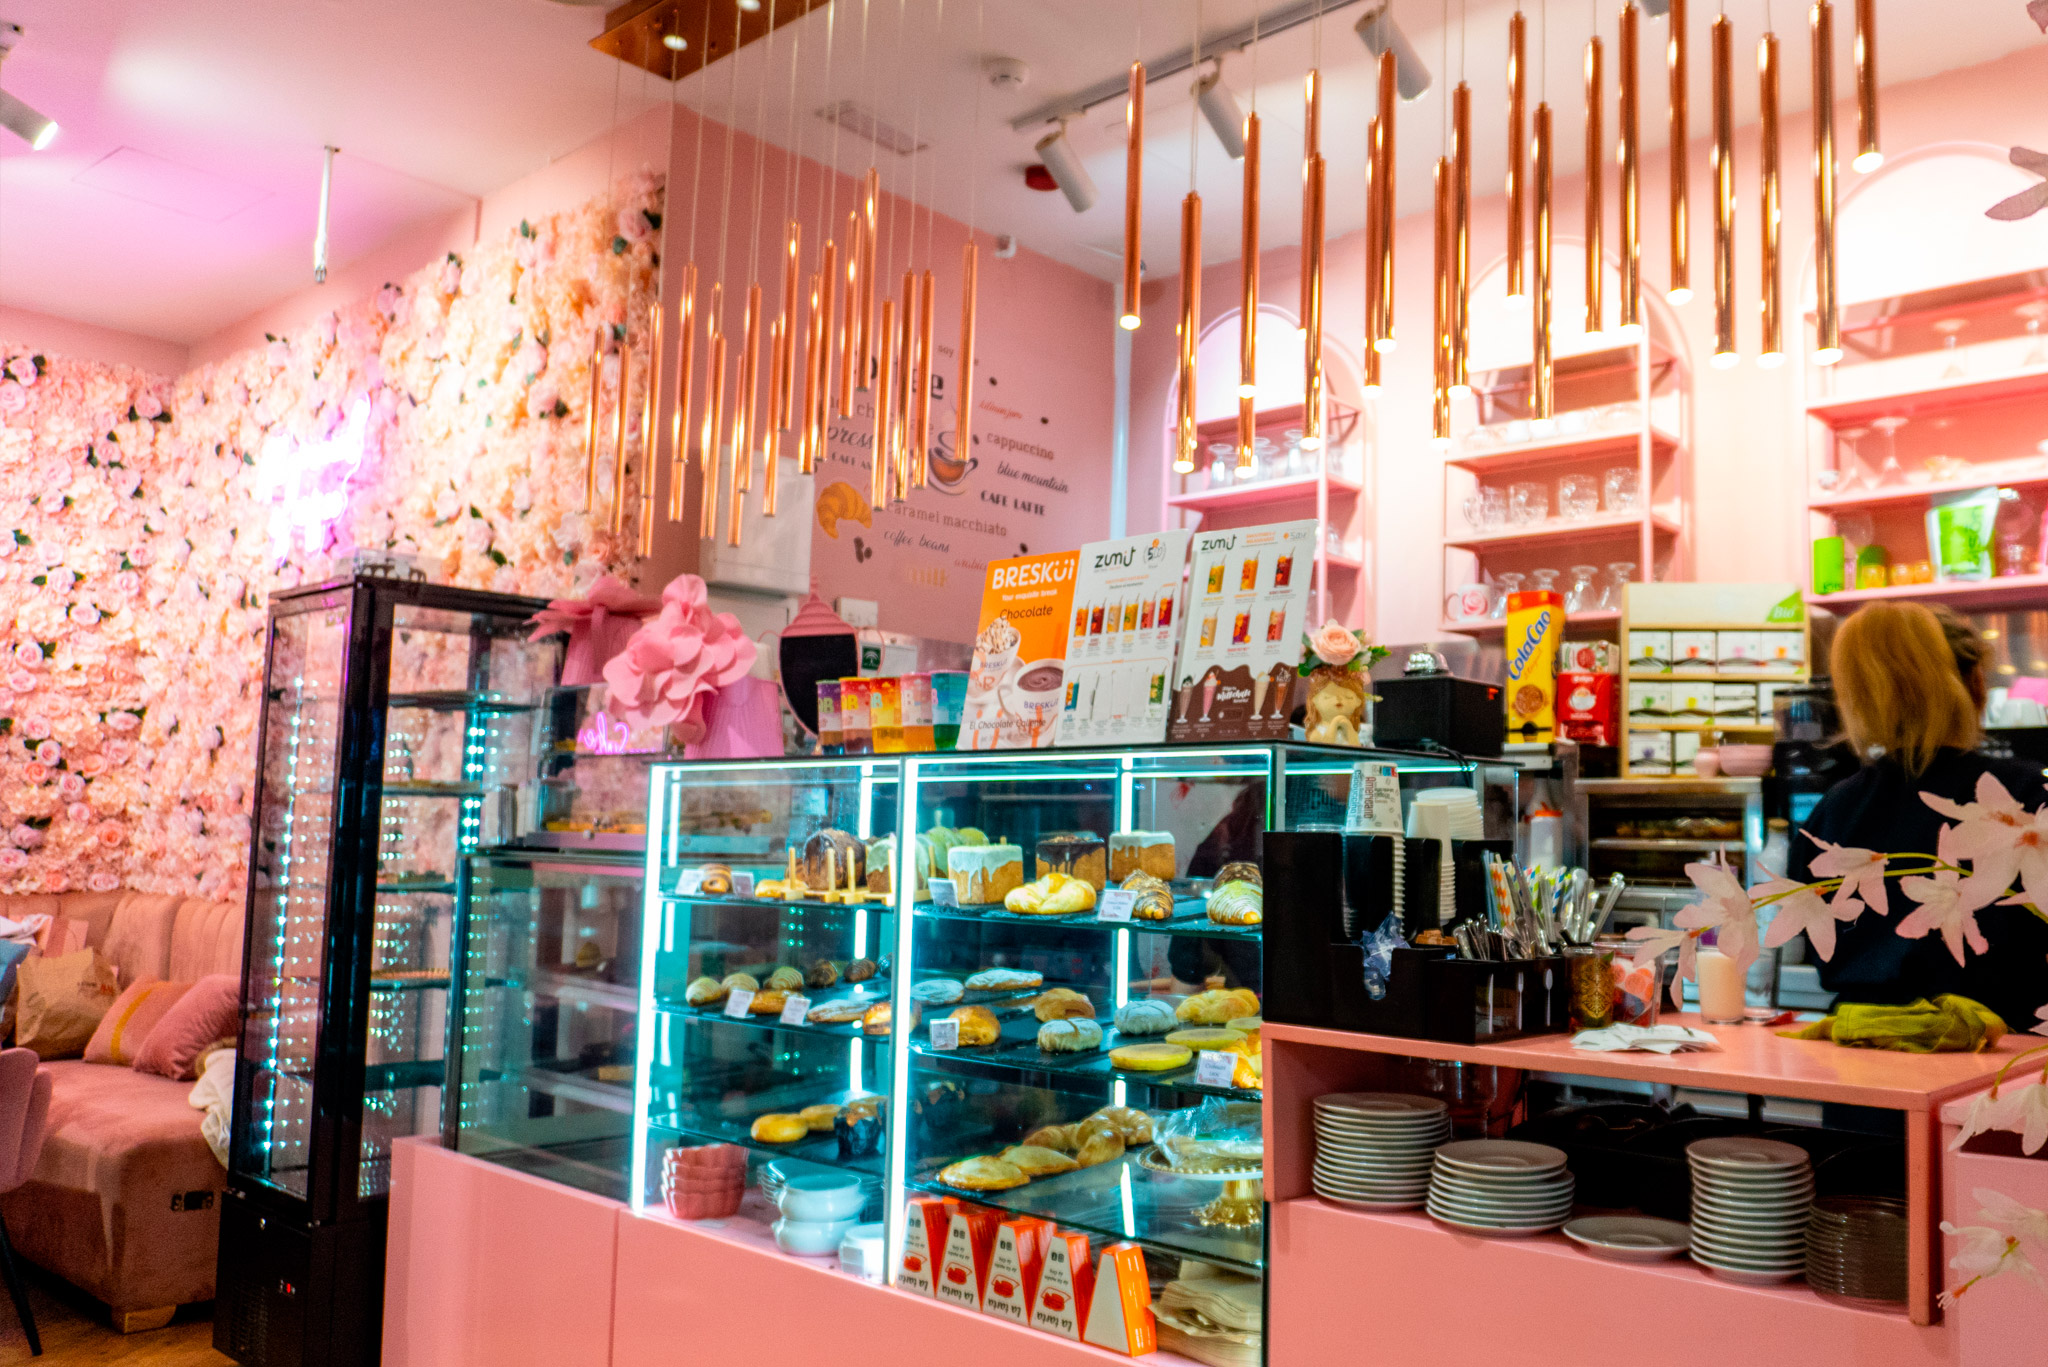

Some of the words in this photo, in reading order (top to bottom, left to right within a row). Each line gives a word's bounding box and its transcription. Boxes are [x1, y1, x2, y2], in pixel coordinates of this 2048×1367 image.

[987, 432, 1055, 461] cappuccino
[997, 461, 1020, 479] blue
[1021, 471, 1069, 494] mountain
[980, 489, 1008, 507] CAFE
[1013, 498, 1046, 516] LATTE
[886, 502, 940, 524] caramel
[942, 514, 1008, 537] macchiato
[884, 529, 914, 548] coffee
[918, 533, 951, 554] beans
[1000, 604, 1054, 621] Chocolate
[1508, 610, 1551, 681] ColaCao
[977, 718, 1014, 730] Chocolate
[1363, 776, 1377, 819] Americano
[941, 1284, 962, 1300] tarta
[987, 1297, 1009, 1313] tarta
[1036, 1311, 1059, 1327] tarta
